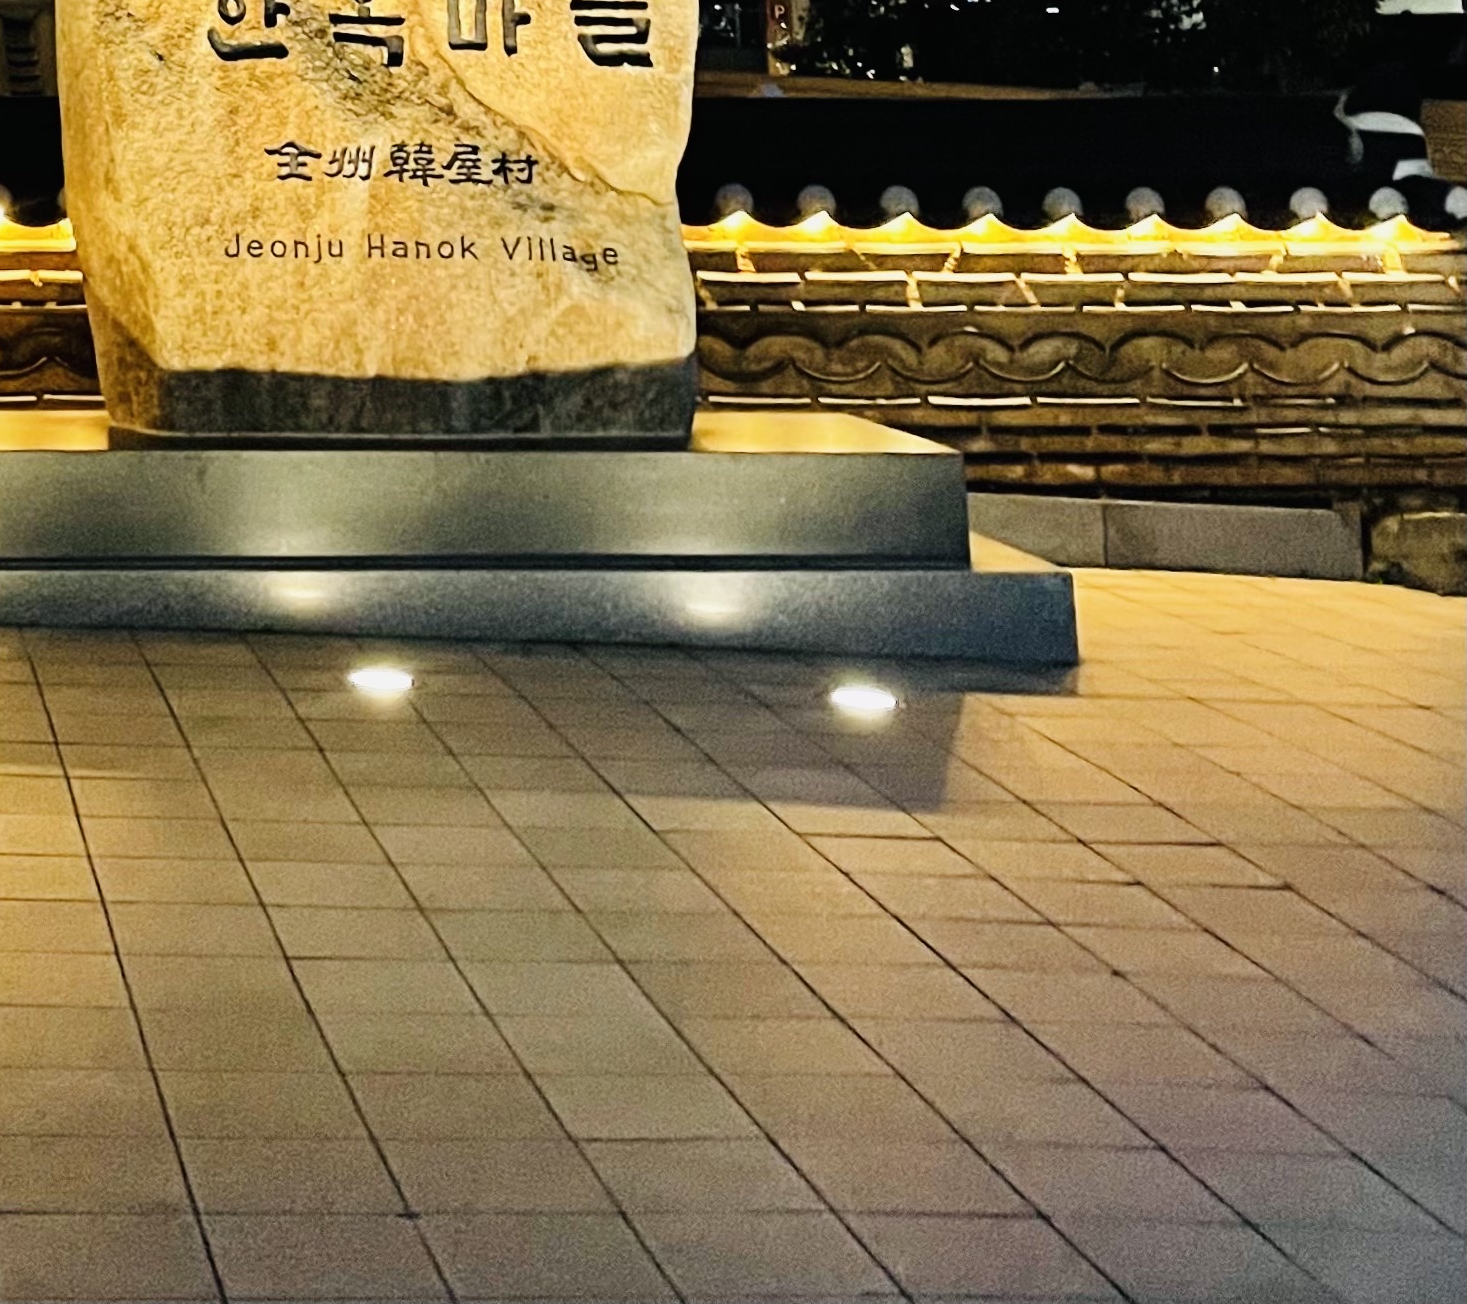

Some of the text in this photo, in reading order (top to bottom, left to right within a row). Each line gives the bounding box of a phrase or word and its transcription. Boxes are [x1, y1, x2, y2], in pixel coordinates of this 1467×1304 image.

[224, 233, 619, 272] Jeonju Hanok Village
